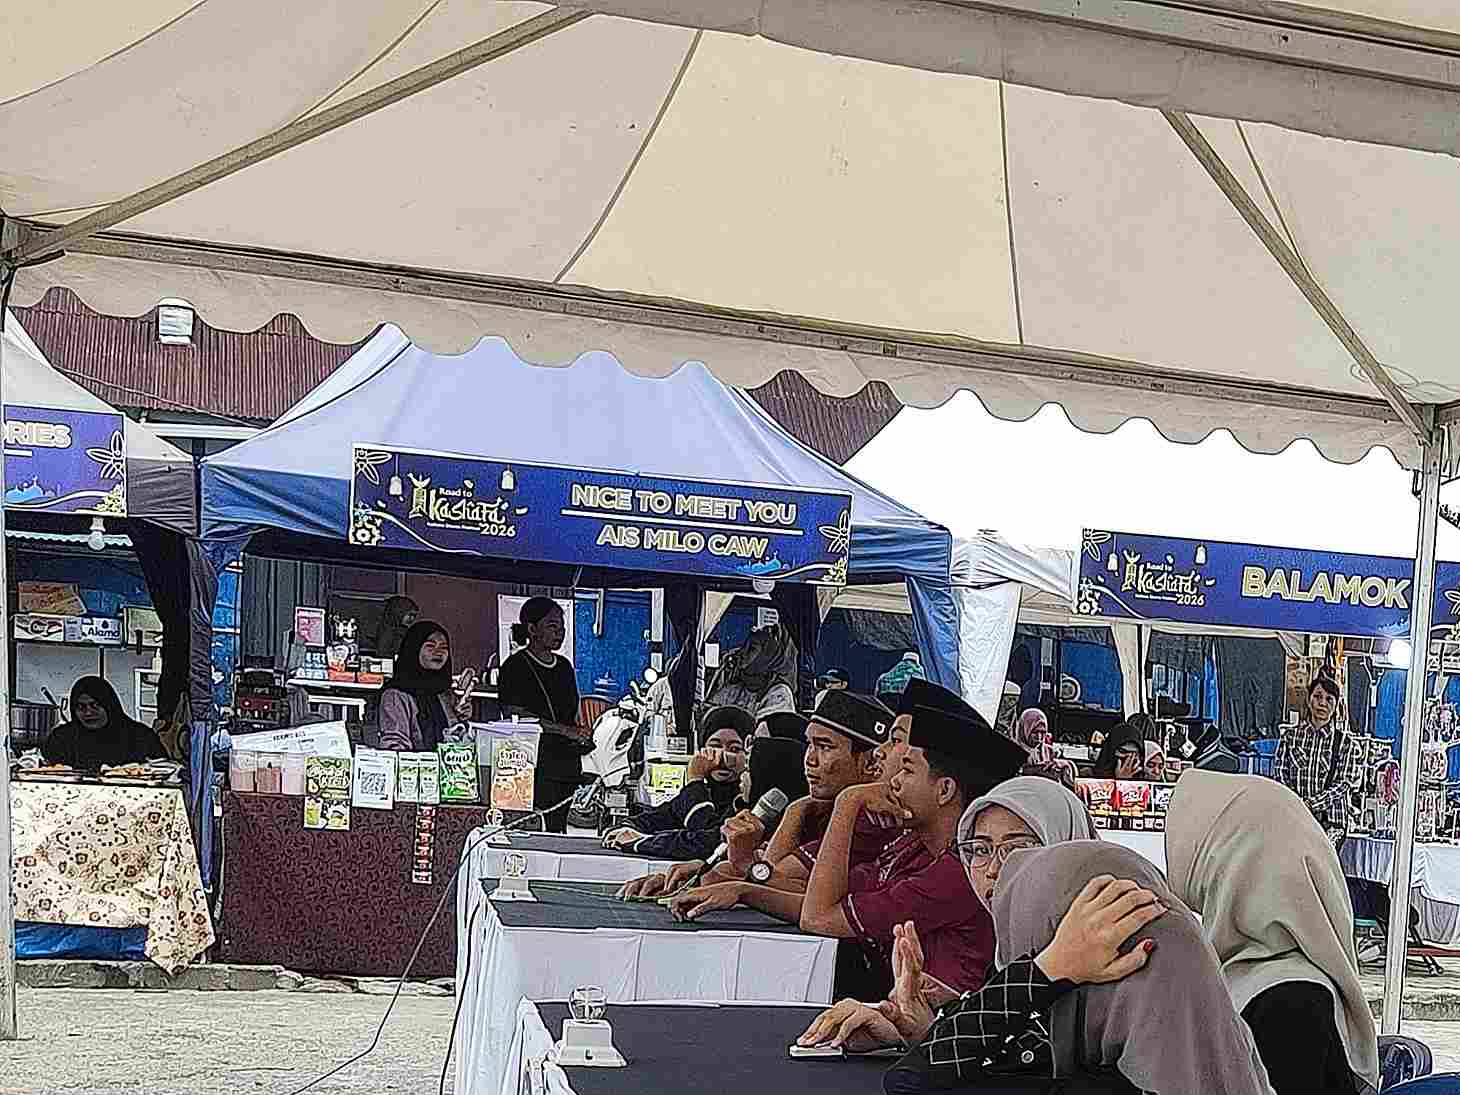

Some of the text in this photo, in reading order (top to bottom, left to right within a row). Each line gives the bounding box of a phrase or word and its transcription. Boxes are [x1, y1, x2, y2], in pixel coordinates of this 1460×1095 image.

[3, 420, 72, 448] RIES
[572, 484, 797, 525] NICE TO MEET YOU
[480, 523, 516, 537] 2026
[597, 525, 769, 559] AIS MILO CAW
[1176, 593, 1205, 606] 2026
[1242, 565, 1411, 609] BALAMOK
